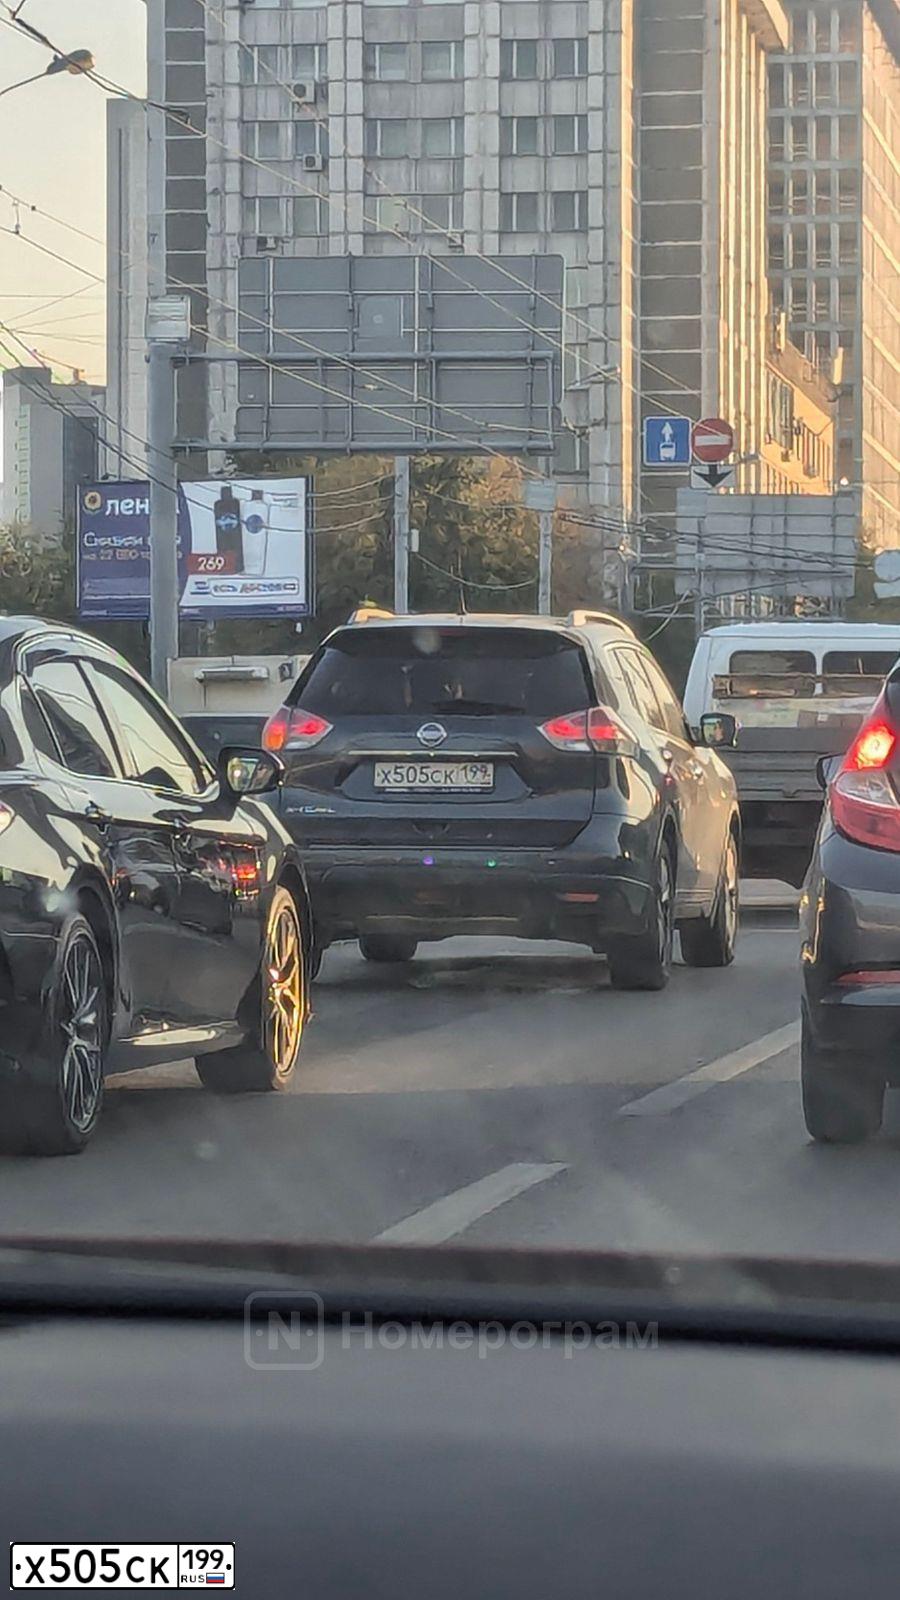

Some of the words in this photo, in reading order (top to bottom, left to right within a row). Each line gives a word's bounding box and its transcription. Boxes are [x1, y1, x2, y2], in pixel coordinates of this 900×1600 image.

[105, 497, 181, 516] лен
[197, 556, 225, 571] 269
[460, 764, 488, 782] 199
